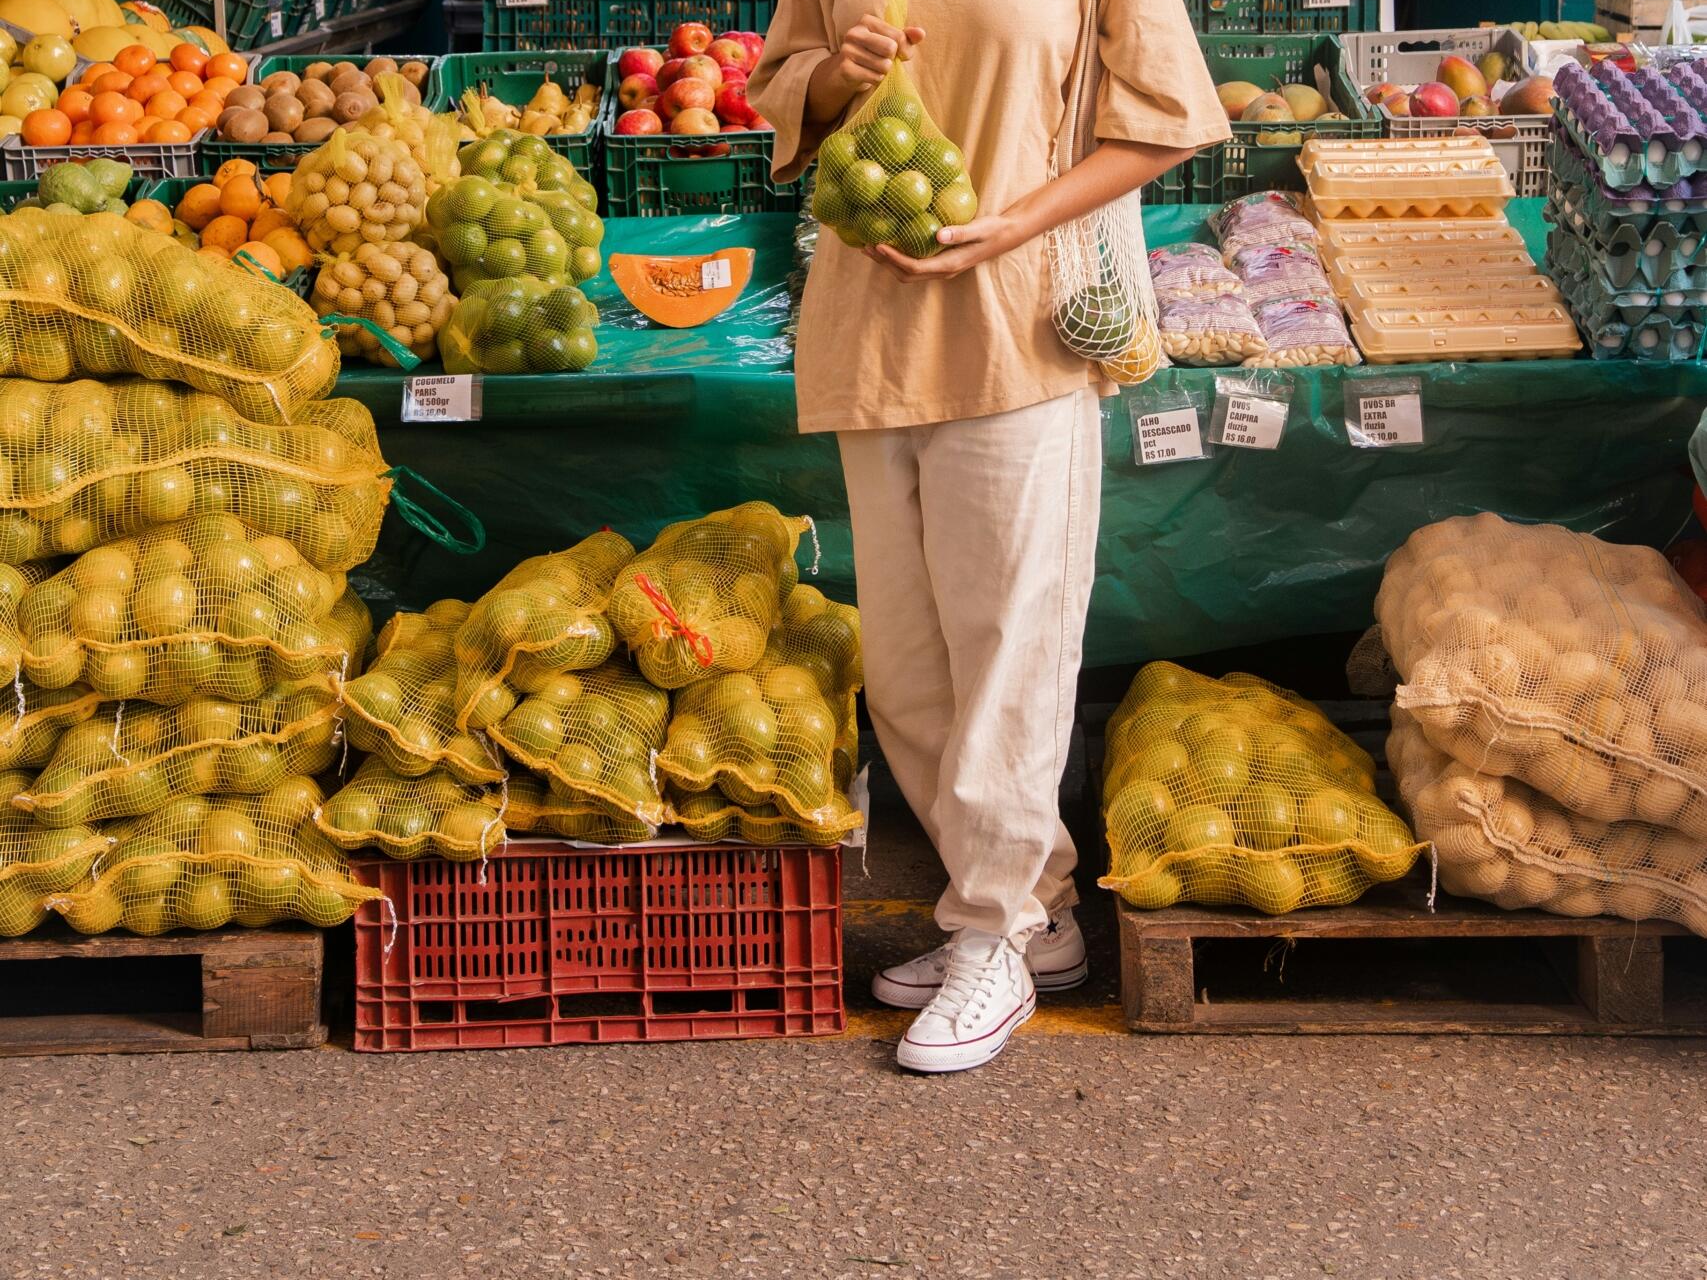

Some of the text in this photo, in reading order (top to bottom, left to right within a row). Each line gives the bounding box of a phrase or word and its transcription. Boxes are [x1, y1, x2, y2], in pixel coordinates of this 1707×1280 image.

[415, 376, 456, 386] COGUMELO
[415, 387, 437, 397] PARIS
[426, 397, 450, 407] 500gr
[1231, 400, 1251, 411] OVOS
[1363, 399, 1396, 410] OVOS BR
[1229, 411, 1259, 424] CAIPIRA
[1363, 411, 1388, 421] EXTRA
[1140, 416, 1160, 427] ALHO
[1142, 423, 1192, 438] DESCASCADO
[1225, 432, 1236, 442] R$
[1377, 431, 1398, 441] 10,00
[1143, 439, 1157, 449] pct
[1145, 447, 1177, 460] R$ 17,00
